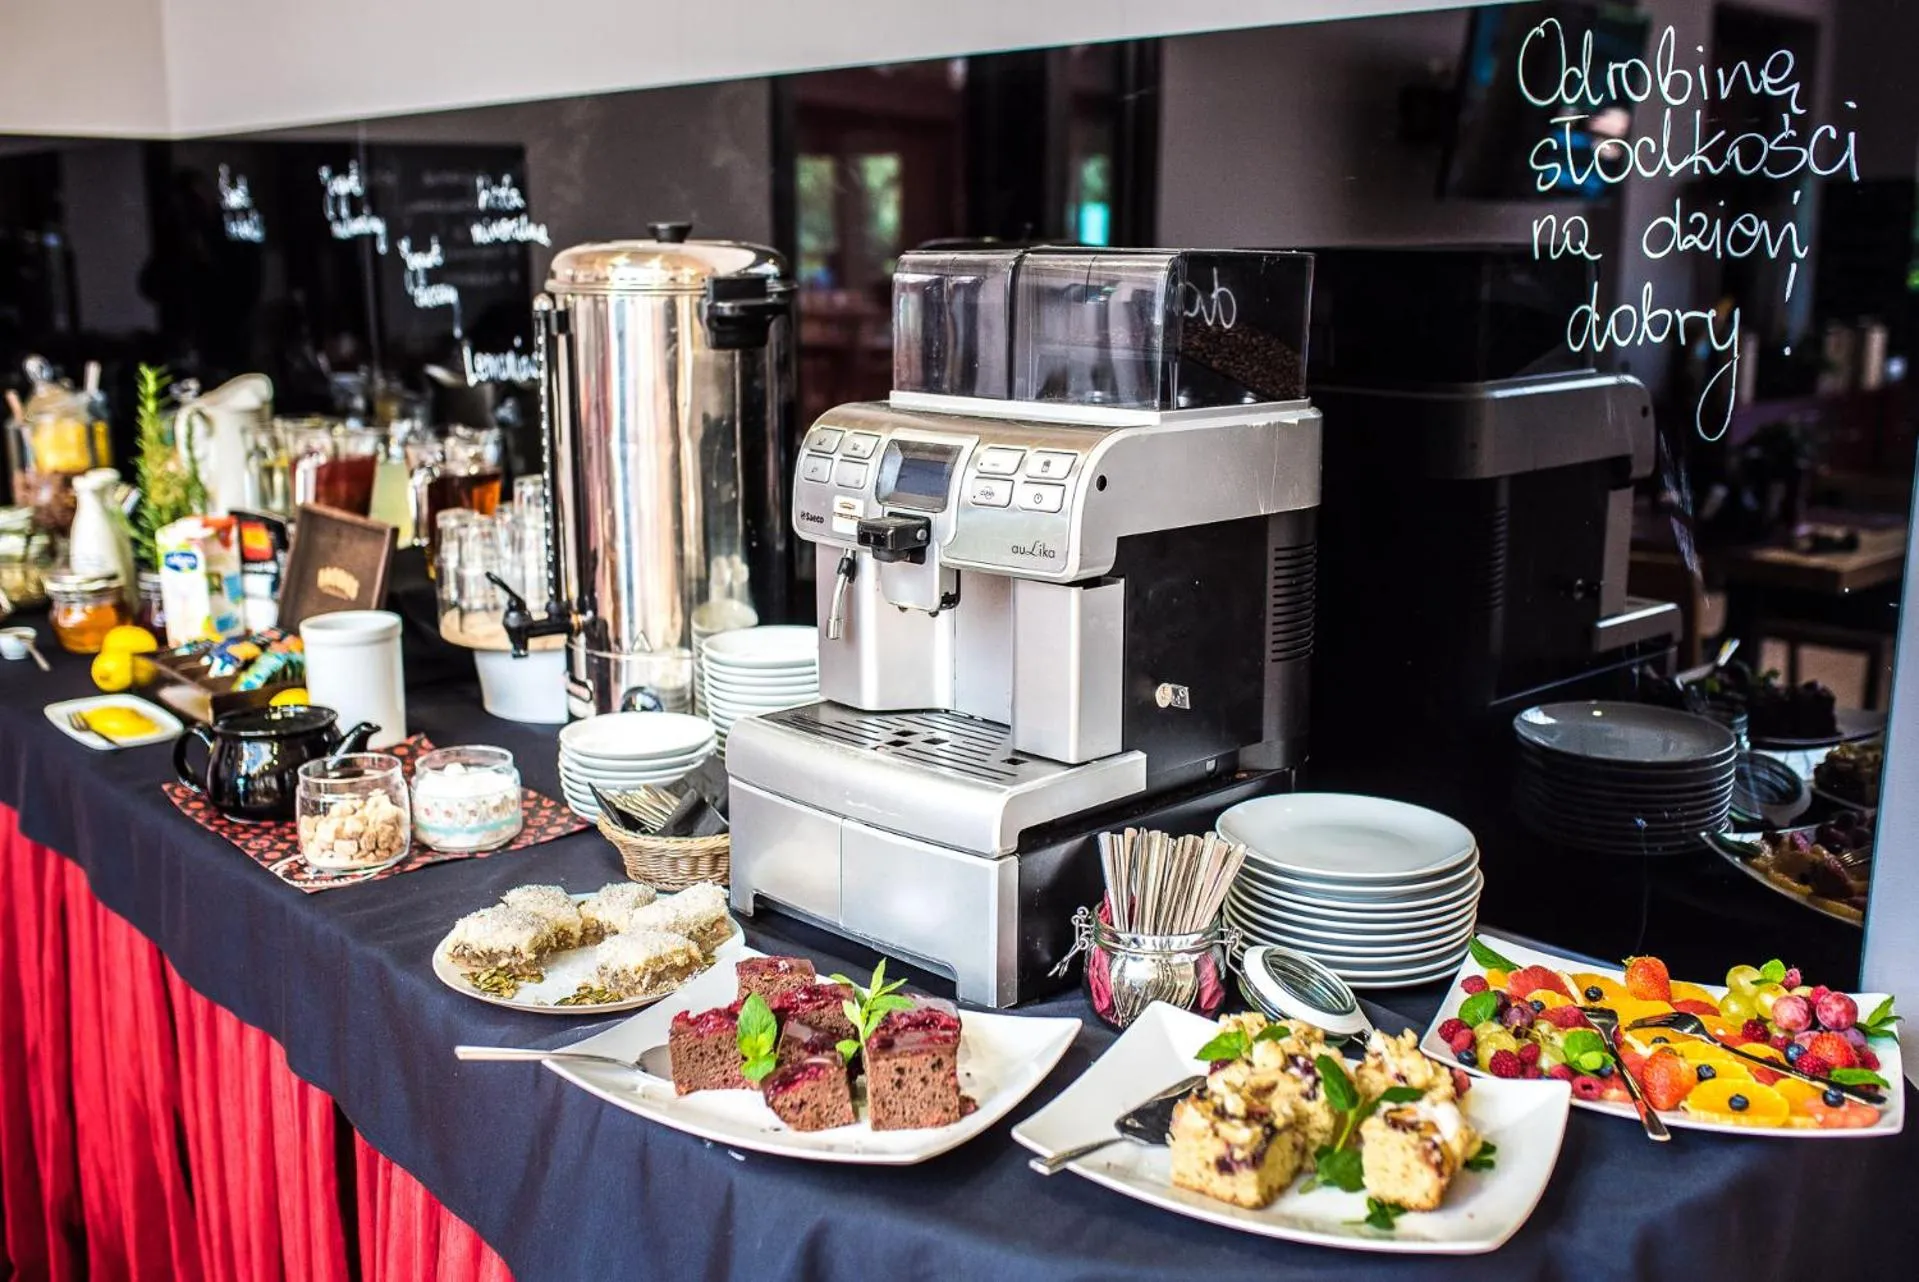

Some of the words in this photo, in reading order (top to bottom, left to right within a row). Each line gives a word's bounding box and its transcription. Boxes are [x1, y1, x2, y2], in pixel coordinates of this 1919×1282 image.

[1517, 17, 1807, 114] Odrobinę
[1528, 101, 1860, 192] słodkości
[1532, 213, 1603, 261] na
[1642, 190, 1810, 260] dzień
[805, 511, 825, 524] Saeco
